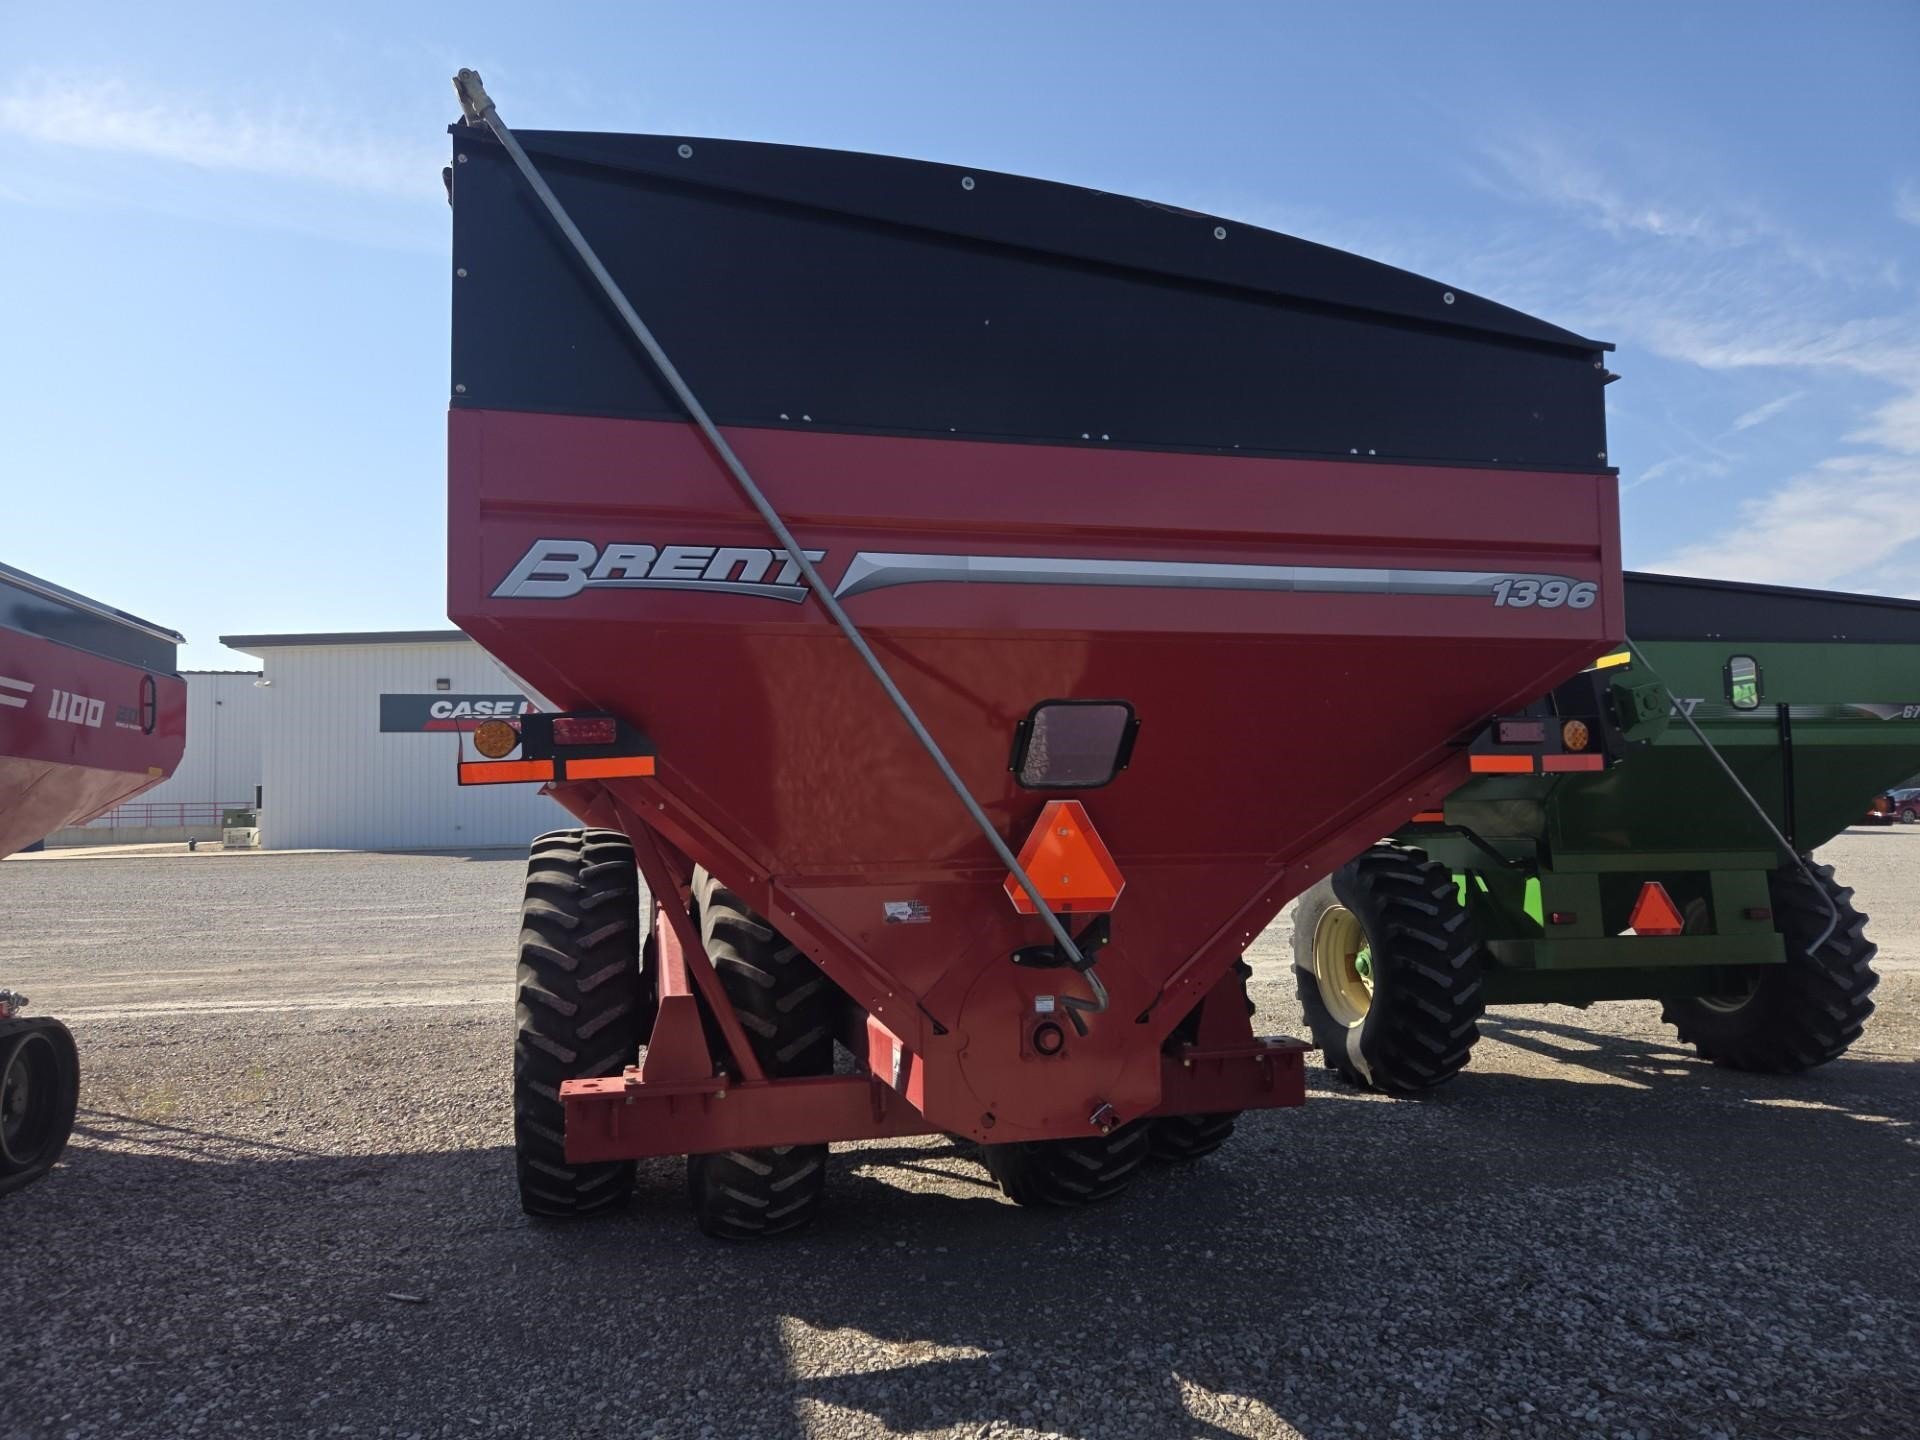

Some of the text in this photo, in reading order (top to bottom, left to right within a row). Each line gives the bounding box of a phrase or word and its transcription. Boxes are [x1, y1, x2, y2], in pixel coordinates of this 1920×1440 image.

[491, 539, 826, 598] BRENT
[1493, 580, 1598, 609] 1396
[47, 688, 106, 728] 1100
[430, 700, 516, 719] CASE
